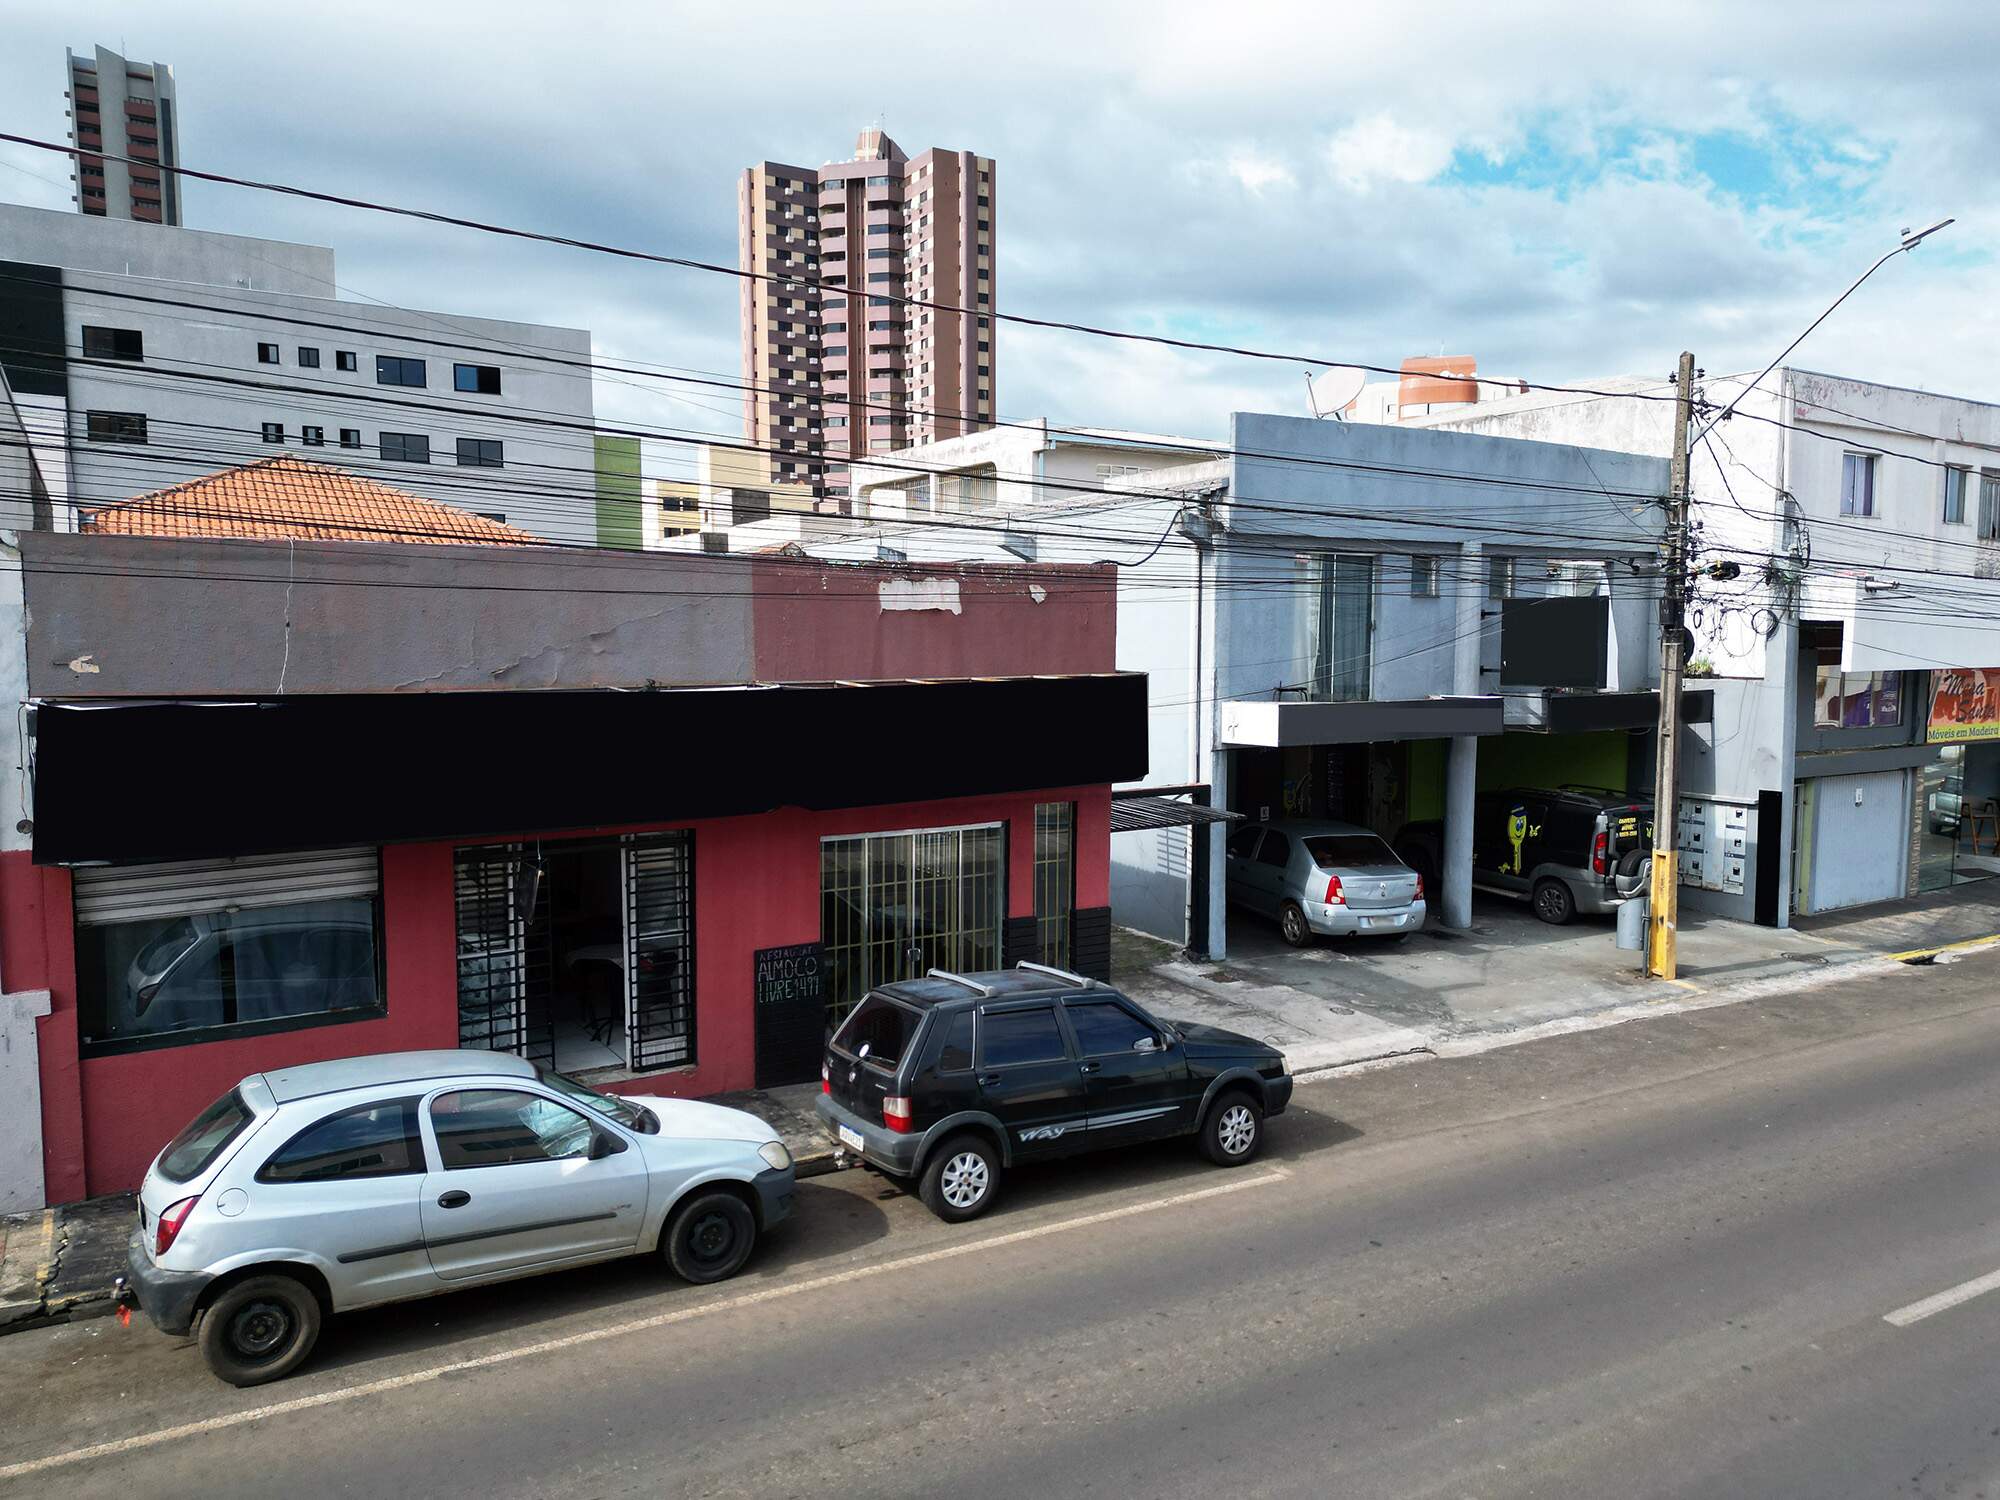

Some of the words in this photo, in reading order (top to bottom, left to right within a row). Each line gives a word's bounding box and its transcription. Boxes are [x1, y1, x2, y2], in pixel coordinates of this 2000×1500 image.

[1928, 727, 1955, 740] Móveis
[1956, 729, 1968, 738] em
[1969, 726, 1998, 737] Madeira
[759, 979, 793, 1004] LIVRE
[1019, 1125, 1065, 1142] Way
